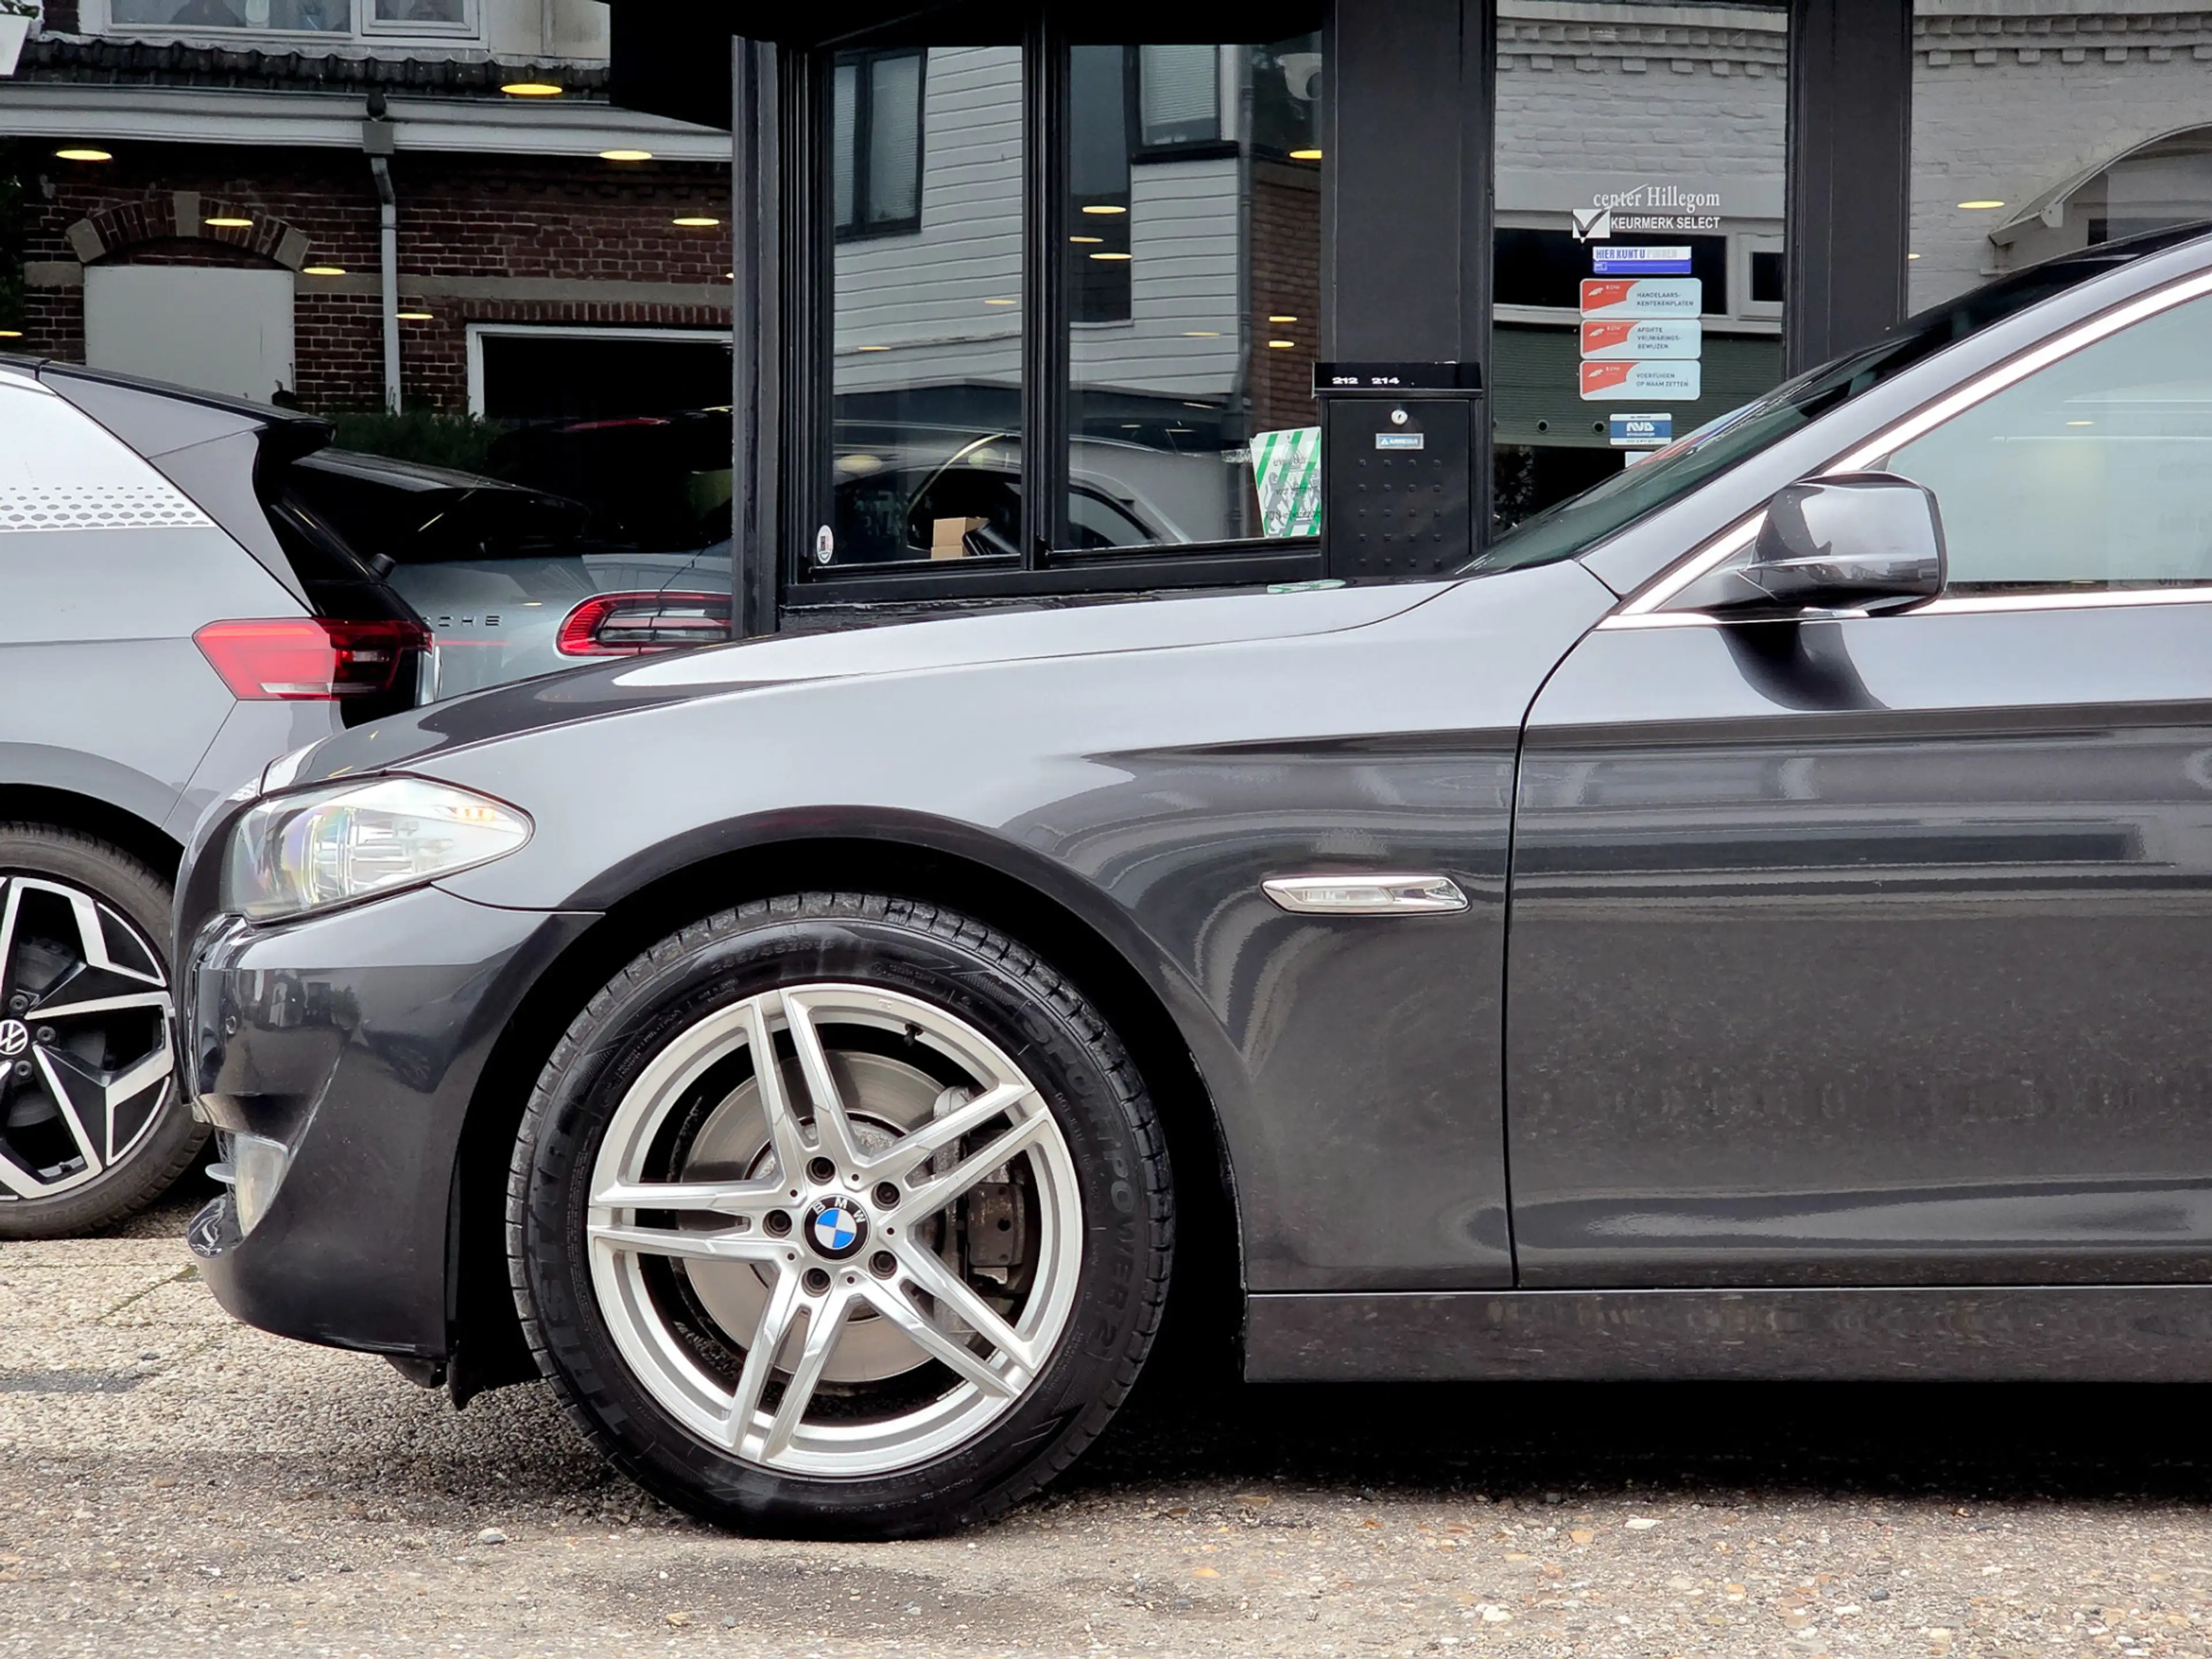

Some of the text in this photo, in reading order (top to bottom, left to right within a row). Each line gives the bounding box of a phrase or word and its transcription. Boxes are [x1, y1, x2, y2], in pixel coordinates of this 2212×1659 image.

[1593, 186, 1720, 213] center Hillegom
[1611, 217, 1720, 229] KEURMERK SELECT
[1596, 249, 1615, 259] HIER
[1616, 249, 1638, 259] KUNT
[1639, 249, 1645, 259] U
[1332, 376, 1400, 385] 212 214
[812, 1196, 866, 1224] BMW
